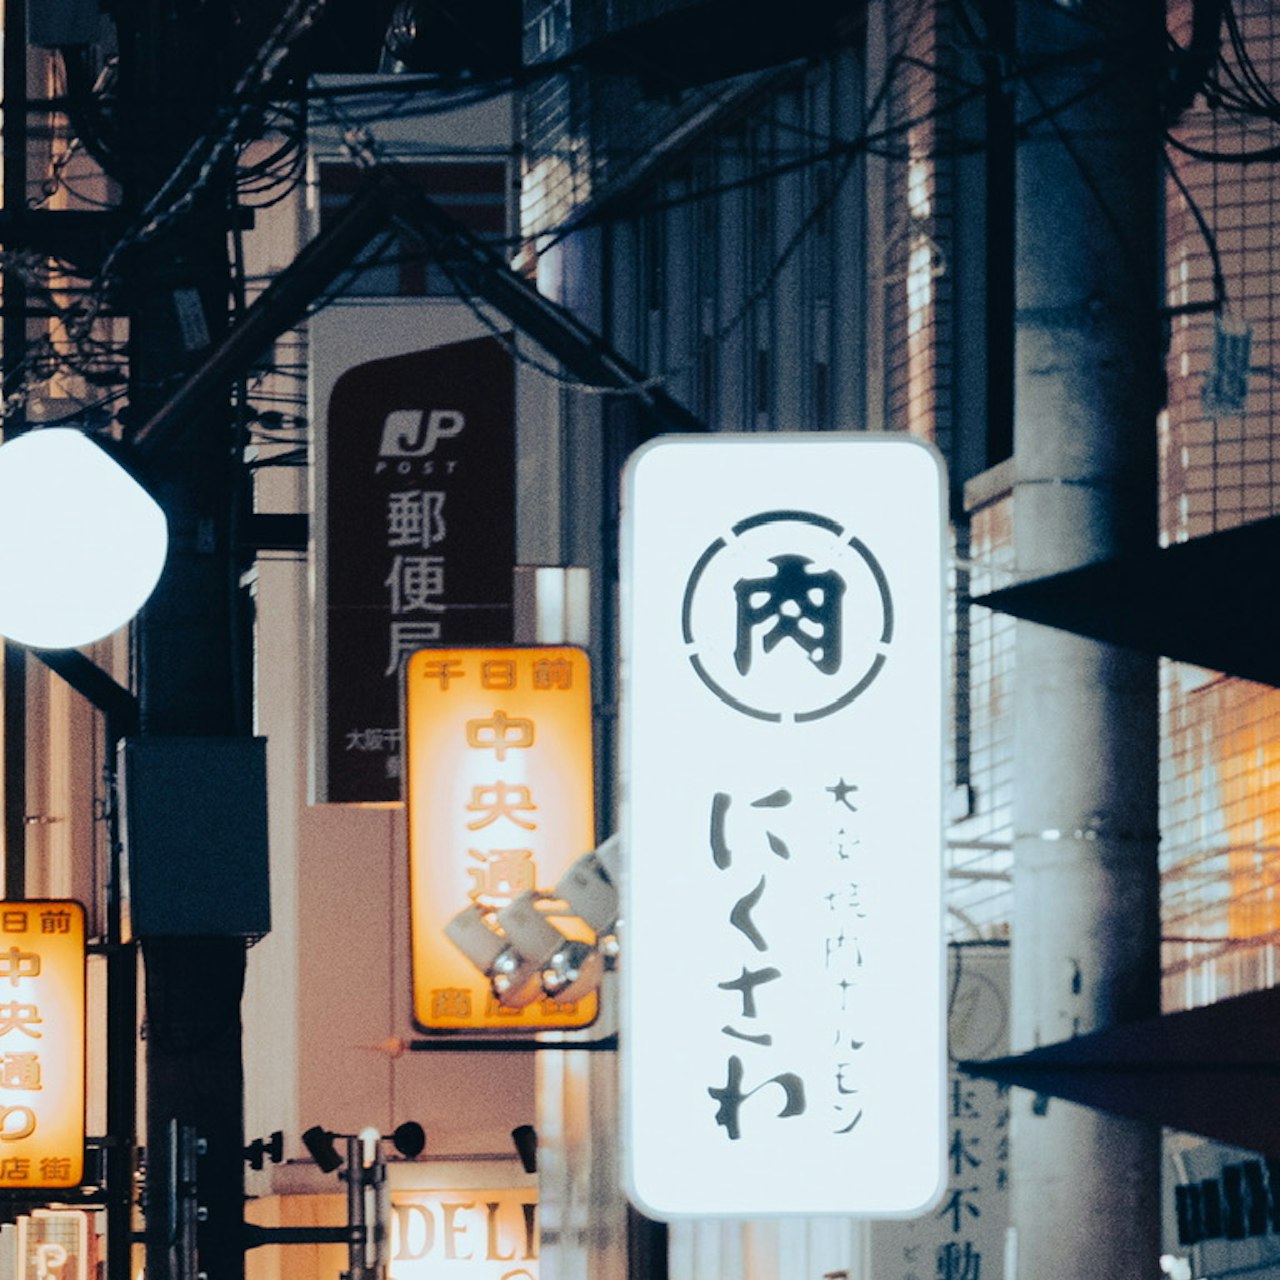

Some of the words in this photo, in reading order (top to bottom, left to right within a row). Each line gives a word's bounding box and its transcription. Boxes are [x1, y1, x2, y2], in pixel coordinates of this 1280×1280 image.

[374, 460, 459, 475] POST
[734, 553, 848, 678] 肉
[424, 658, 573, 691] 千日前
[463, 708, 539, 935] 中央通
[707, 789, 807, 1141] にくさわ
[391, 1202, 539, 1261] DELI
